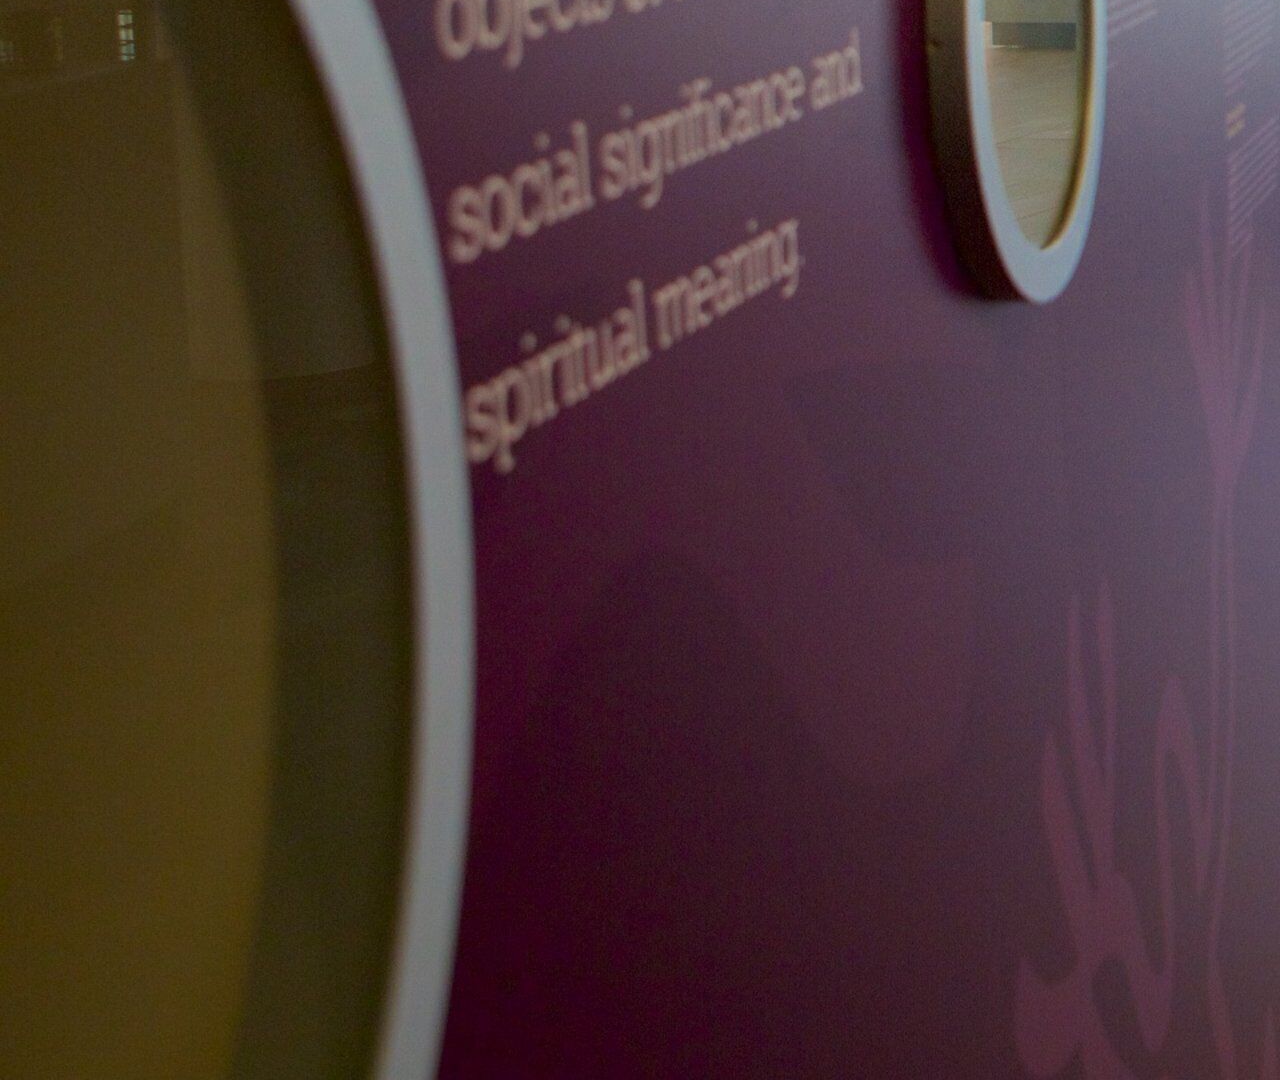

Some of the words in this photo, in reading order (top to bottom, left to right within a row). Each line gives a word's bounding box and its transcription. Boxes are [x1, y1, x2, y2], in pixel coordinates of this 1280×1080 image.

[446, 120, 595, 265] social
[600, 65, 806, 209] significance
[809, 26, 864, 111] and
[464, 277, 653, 476] spiritual
